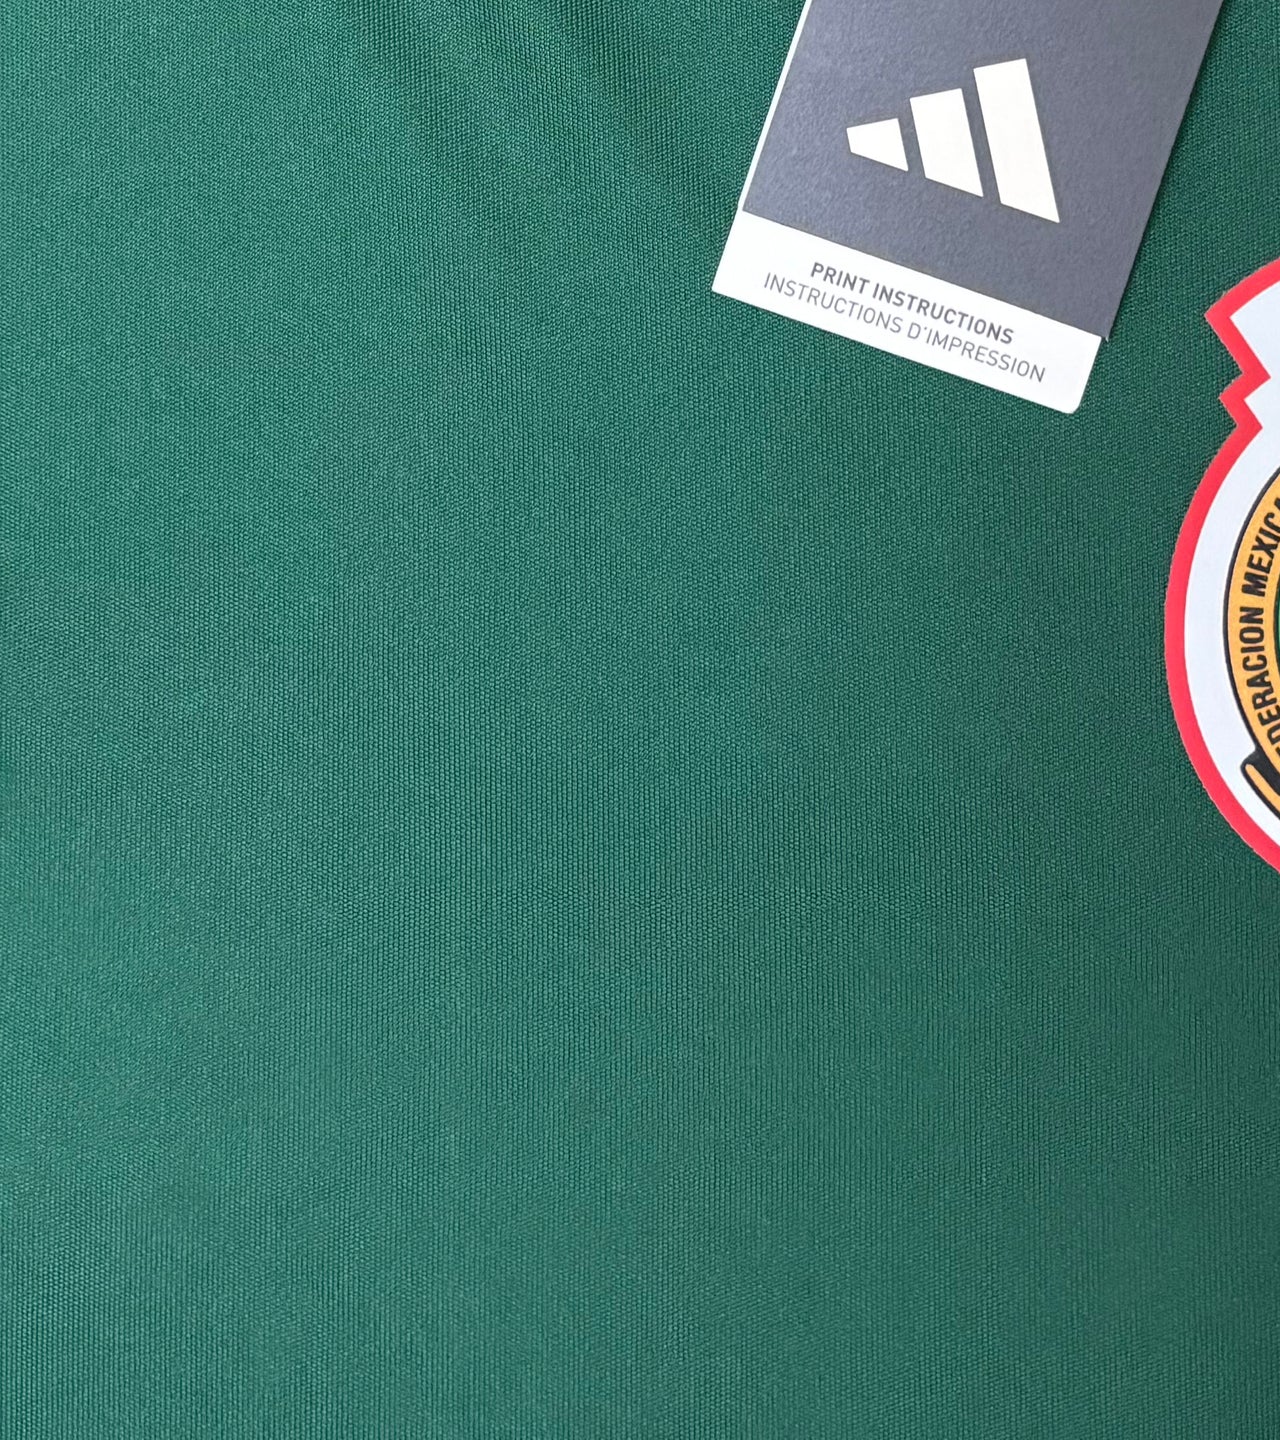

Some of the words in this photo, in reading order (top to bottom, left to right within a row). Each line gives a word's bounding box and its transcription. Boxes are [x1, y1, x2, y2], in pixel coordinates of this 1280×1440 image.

[763, 271, 903, 334] INSTRUCTIONS
[907, 323, 1047, 383] D'IMPRESSION
[810, 262, 871, 295] PRINT
[872, 282, 1015, 345] INSTRUCTIONS
